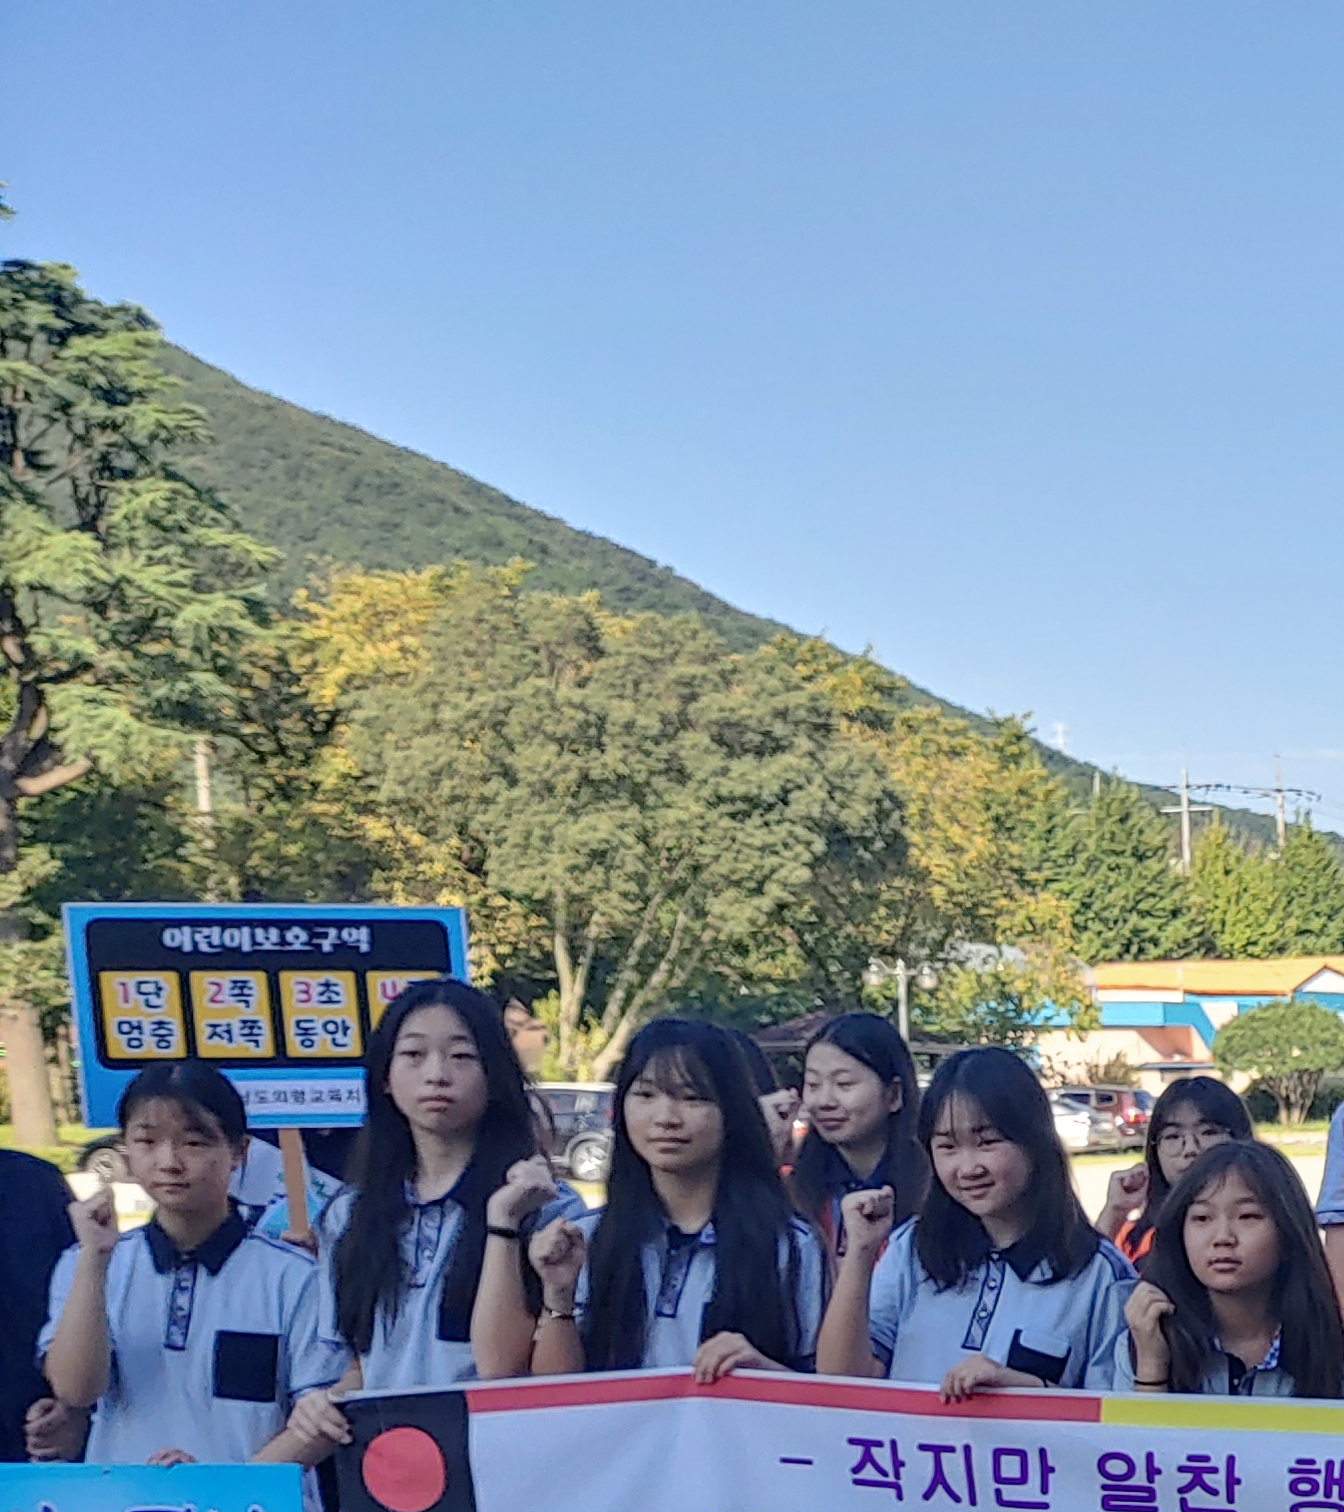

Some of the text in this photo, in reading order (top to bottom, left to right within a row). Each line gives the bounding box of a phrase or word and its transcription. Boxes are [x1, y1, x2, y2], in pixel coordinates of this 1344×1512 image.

[162, 925, 372, 952] 어린이보호구역
[117, 979, 164, 1009] 1단
[207, 979, 254, 1009] 2쪽
[294, 979, 343, 1005] 3초
[206, 1019, 264, 1049] 저쪽
[294, 1018, 350, 1049] 동안
[848, 1435, 1057, 1512] 작지만
